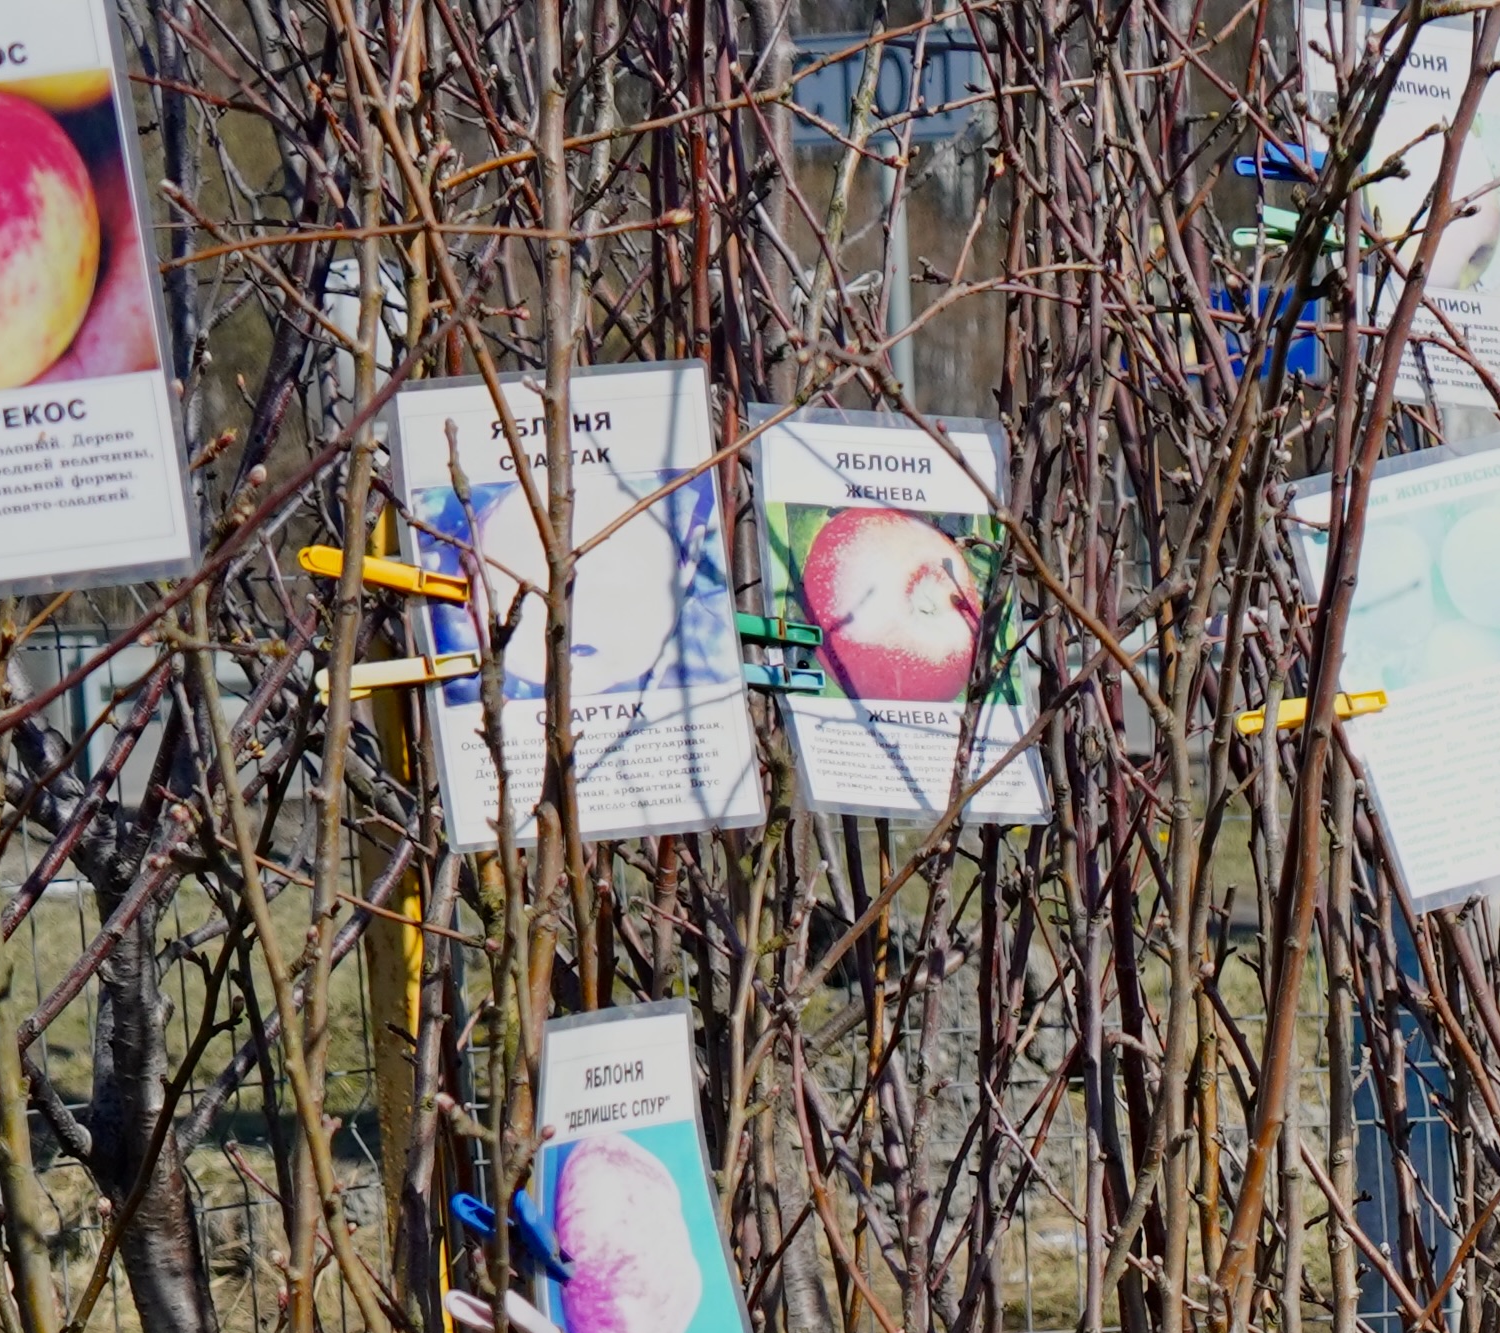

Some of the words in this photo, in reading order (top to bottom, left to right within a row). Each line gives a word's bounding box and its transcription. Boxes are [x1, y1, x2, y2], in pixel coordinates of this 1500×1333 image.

[488, 411, 612, 440] ЯБЛНЯ
[835, 452, 931, 474] ЯБЛОНЯ
[845, 484, 926, 502] ЖЕНЕВА
[535, 700, 646, 728] САРТАК
[865, 708, 949, 726] ЖЕНЕВА
[615, 767, 655, 781] белая,
[690, 776, 721, 789] Вкус
[585, 1059, 644, 1090] ЯБЛОНЯ
[564, 1101, 627, 1134] "ДЕЛИШЕС
[632, 1094, 671, 1117] СПУР"
